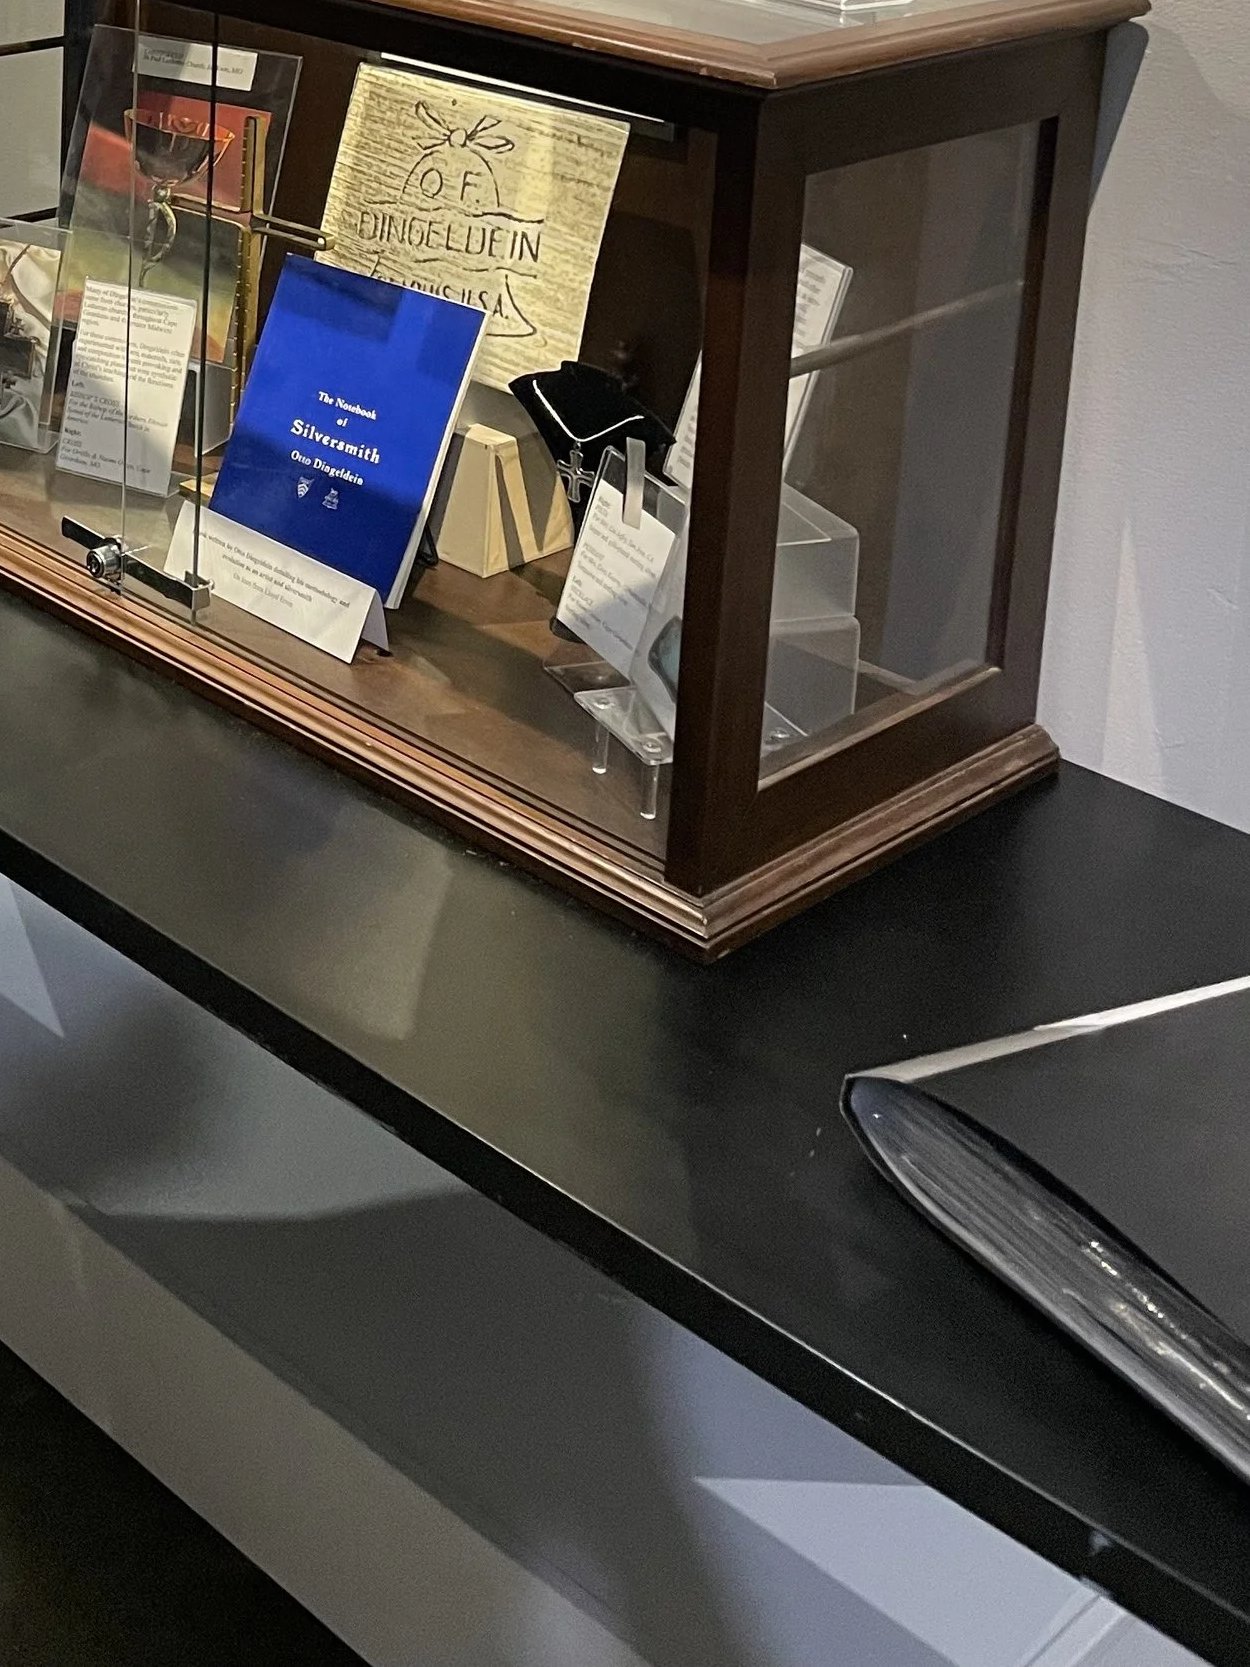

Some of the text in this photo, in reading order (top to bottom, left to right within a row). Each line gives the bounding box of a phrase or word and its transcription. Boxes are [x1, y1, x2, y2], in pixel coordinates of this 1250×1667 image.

[356, 211, 541, 263] DINGELDEIN
[318, 391, 376, 420] The Notebook
[336, 418, 348, 427] of
[290, 419, 380, 464] Silversmith
[291, 450, 364, 485] Otto Dingeldein
